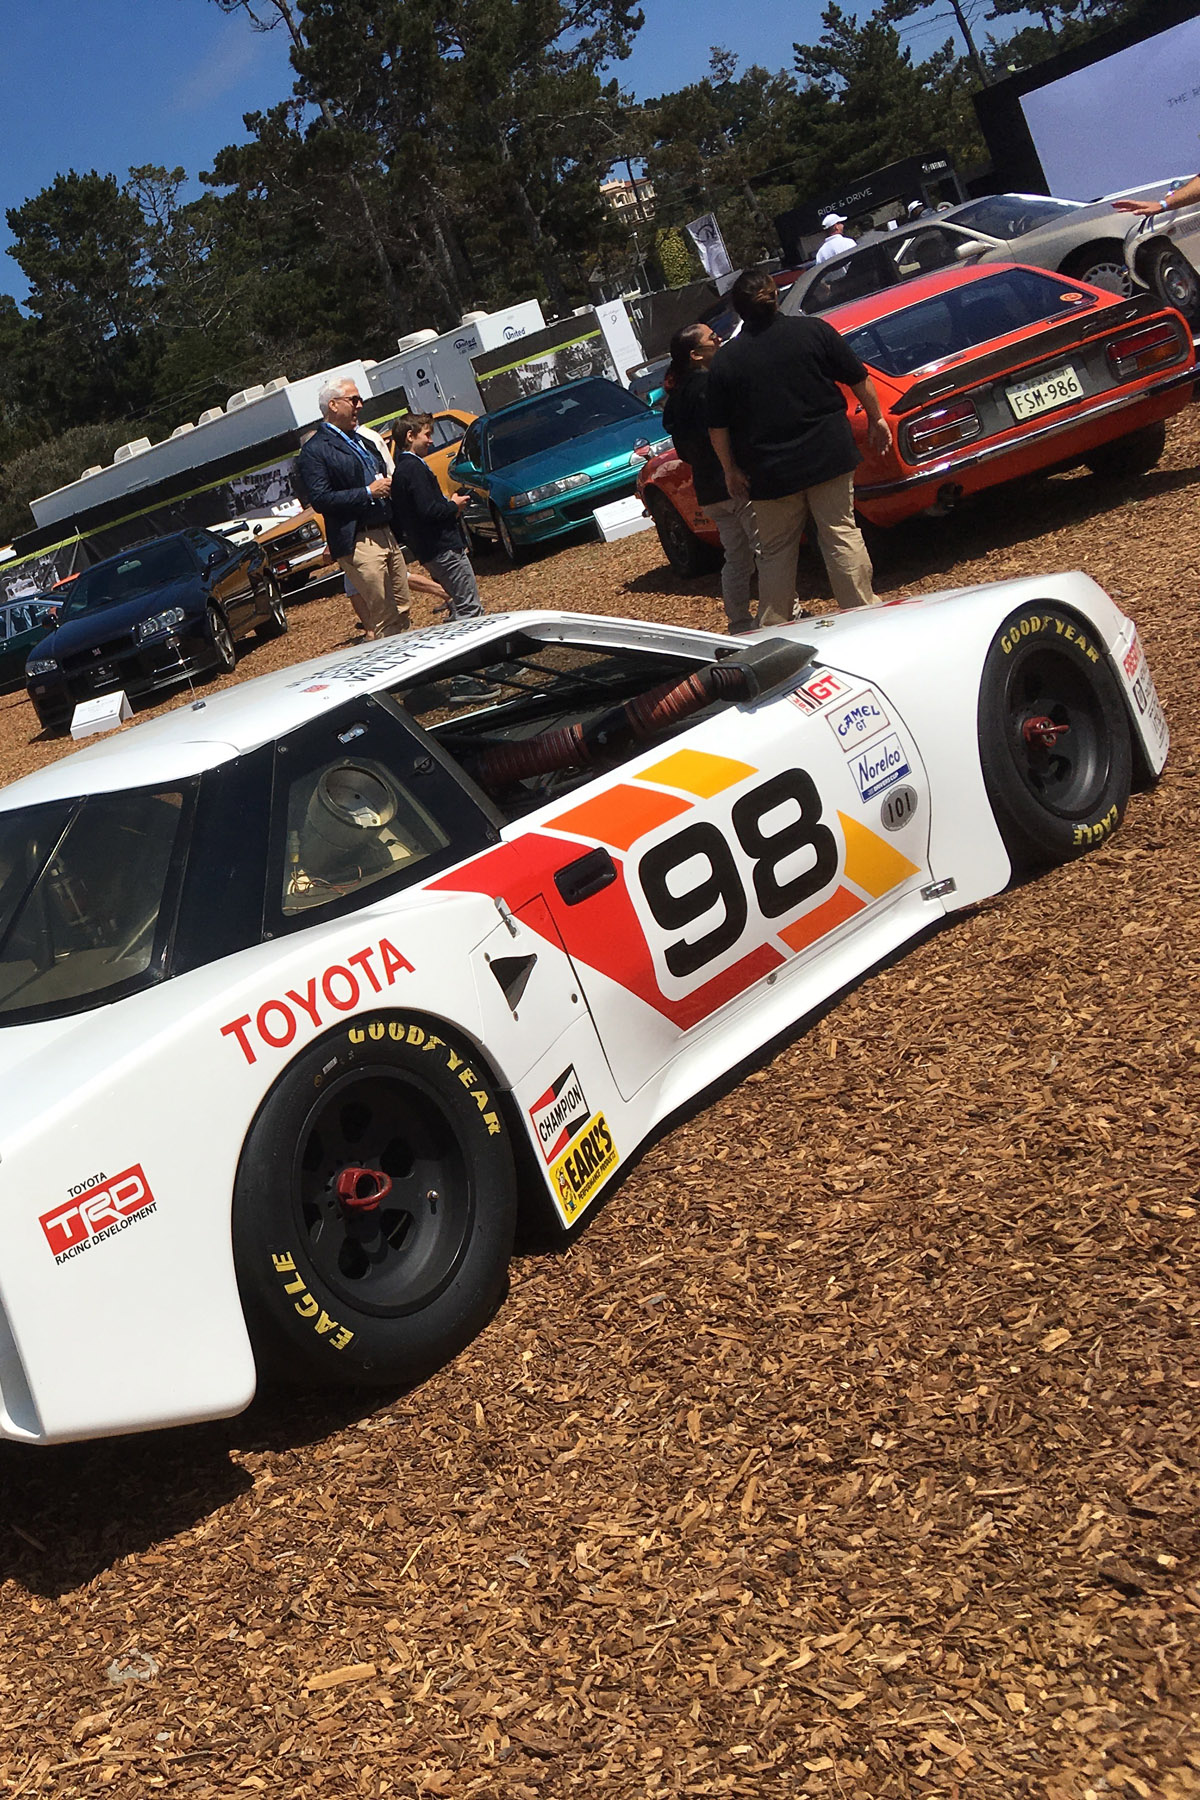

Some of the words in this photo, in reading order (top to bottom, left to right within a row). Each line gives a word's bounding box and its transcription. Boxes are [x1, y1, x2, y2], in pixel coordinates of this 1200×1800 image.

[817, 202, 838, 217] RIDE
[839, 199, 845, 207] &
[846, 187, 873, 204] DRIVE
[504, 327, 526, 341] United
[610, 314, 618, 325] 9
[455, 337, 476, 350] United
[345, 652, 417, 684] WILLY
[808, 675, 841, 700] GT
[837, 705, 880, 736] CAMEL
[856, 719, 867, 731] GT
[858, 746, 901, 790] Norelco
[887, 792, 912, 823] 101
[1072, 804, 1119, 846] EAGLE
[638, 768, 838, 978] 98
[220, 938, 416, 1065] TOYOTA
[348, 1021, 500, 1135] GOODYEAR
[538, 1083, 582, 1142] CHAMPION
[564, 1116, 613, 1192] EARL'S
[67, 1172, 108, 1198] TOYOTA
[45, 1175, 145, 1239] TRD
[54, 1239, 92, 1266] RACING
[91, 1202, 158, 1245] DEVELOPMENT
[271, 1251, 355, 1350] EAGLE
